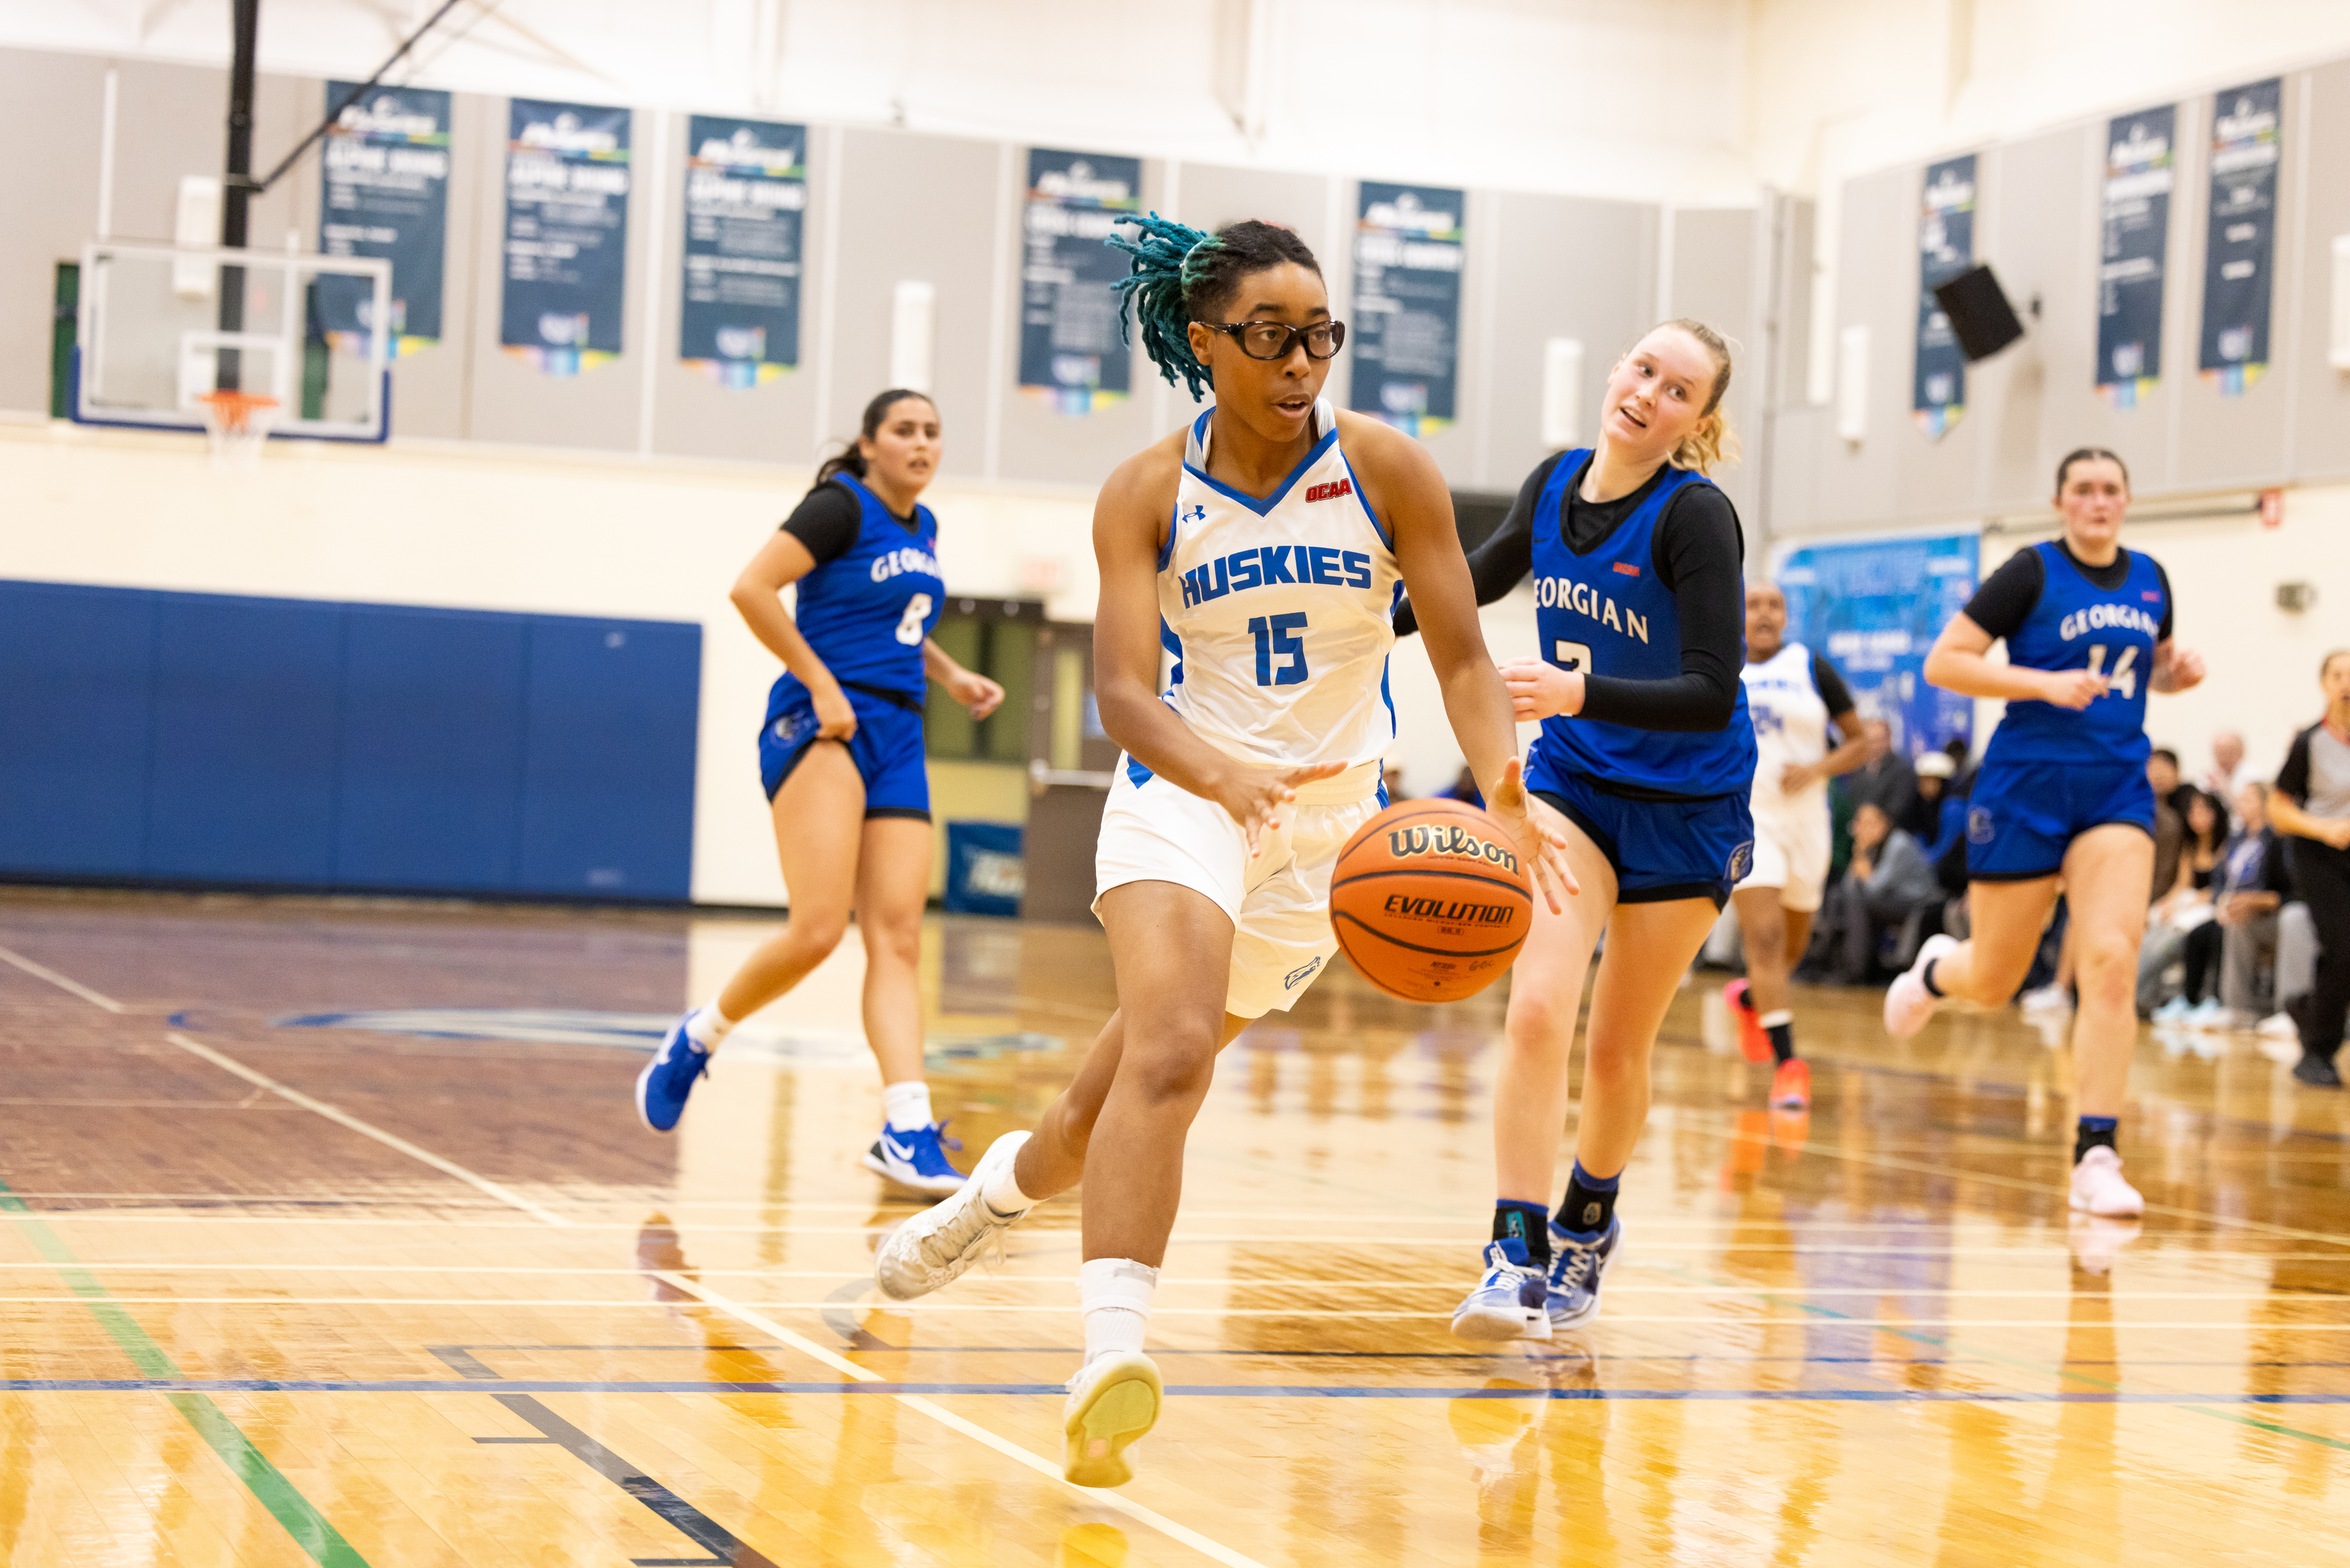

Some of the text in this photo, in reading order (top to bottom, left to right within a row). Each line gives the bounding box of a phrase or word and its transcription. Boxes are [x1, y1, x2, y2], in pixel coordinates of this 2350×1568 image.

[1305, 478, 1352, 503] OCAA
[1178, 545, 1372, 609] HUSKIES
[895, 593, 933, 646] 8
[1534, 576, 1649, 645] EORGIAN
[1248, 611, 1309, 686] 15
[1388, 825, 1520, 876] Wilson
[1384, 894, 1515, 923] EVOLUTION
